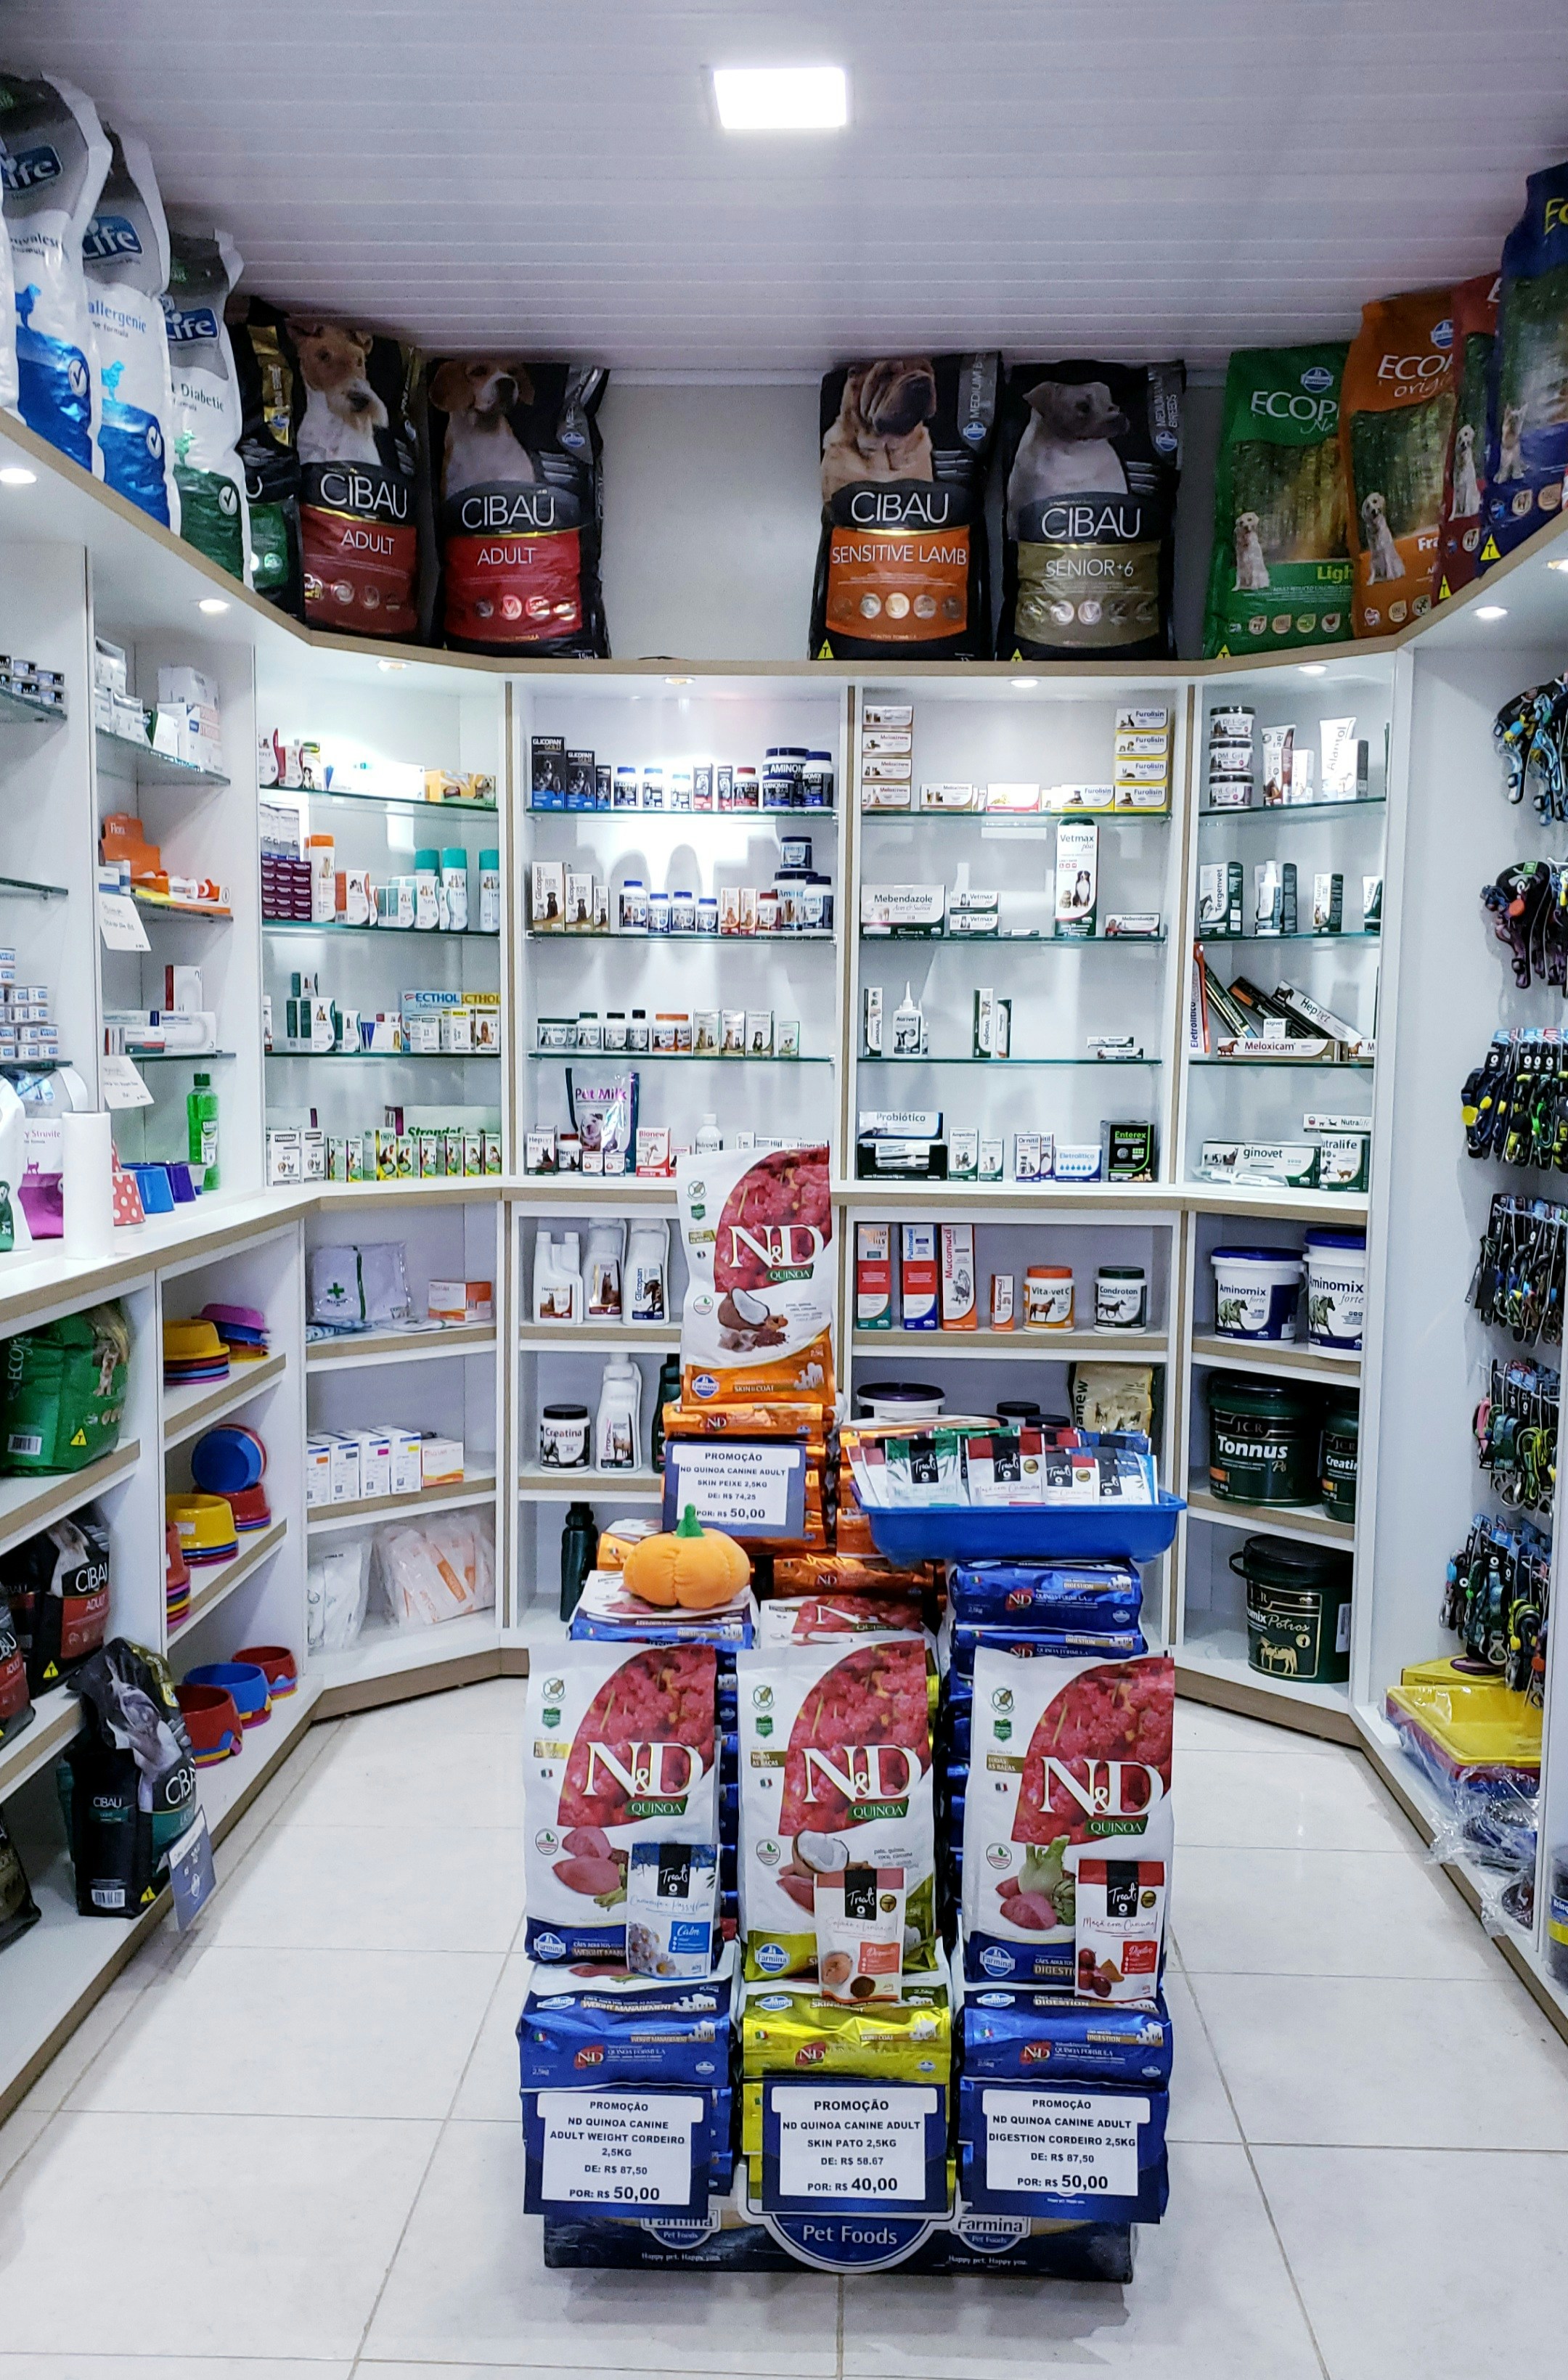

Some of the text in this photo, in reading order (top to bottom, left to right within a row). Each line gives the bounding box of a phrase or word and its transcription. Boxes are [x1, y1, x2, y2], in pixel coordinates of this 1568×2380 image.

[1250, 391, 1338, 420] ECOP
[320, 473, 407, 520] CIBAU
[462, 496, 555, 528] CIBAU
[851, 491, 949, 523] CIBAU
[1042, 507, 1140, 539] CIBAU
[341, 530, 394, 555] ADULT
[477, 547, 536, 565] ADULT
[832, 544, 967, 565] SENSITIVE LAMB
[874, 894, 933, 904] Mebendazole
[416, 993, 460, 1002] ECTHOL
[1244, 1041, 1294, 1051] Meloxicam
[576, 1087, 627, 1100] Pet Milk
[876, 1112, 926, 1122] Probiótico
[31, 1129, 61, 1139] Struvite
[1244, 1147, 1283, 1159] ginovet
[729, 1224, 824, 1268] N&D
[770, 1270, 811, 1280] QUINOA
[1220, 1284, 1266, 1296] Aminomix
[1309, 1275, 1363, 1293] Aminomix
[1100, 1286, 1138, 1296] Condroton
[1339, 1292, 1363, 1306] forte
[545, 1428, 582, 1438] Creatina
[1218, 1435, 1288, 1459] Tonnus
[705, 1452, 762, 1463] PROMOÇÃO
[730, 1508, 765, 1520] 50,00
[1267, 1614, 1310, 1632] Potros
[582, 1742, 703, 1797] N&D
[801, 1745, 922, 1803] N&D
[1039, 1757, 1163, 1816] N&D
[93, 1796, 122, 1807] CIBAU
[632, 1802, 682, 1814] QUINOA
[854, 1805, 904, 1818] QUINOA
[1090, 1821, 1145, 1833] QUINOA
[660, 1864, 688, 1885] Treats
[847, 1888, 875, 1907] Treats
[1108, 1882, 1138, 1904] Treats
[677, 1925, 700, 1937] Calm
[589, 2101, 648, 2112] PROMOÇÃO
[814, 2099, 889, 2113] PROMOÇÃO
[1032, 2099, 1091, 2111] PROMOÇÃO
[586, 2118, 626, 2127] QUINOA
[629, 2120, 669, 2129] CANINE
[801, 2122, 841, 2130] QUINOA
[1010, 2117, 1051, 2126] QUINOA
[1055, 2119, 1093, 2127] CANINE
[550, 2130, 685, 2144] ADULT WEIGHT CORDEIRO
[989, 2133, 1135, 2147] DIGESTION CORDEIRO 2,5KG
[867, 2140, 897, 2148] 2,5KG
[602, 2148, 632, 2157] 2,5KG
[1050, 2154, 1063, 2162] R$
[1067, 2154, 1094, 2164] 87,50
[841, 2157, 853, 2166] R$
[584, 2164, 648, 2175] DE: R$ 87,50
[836, 2183, 847, 2191] R$
[852, 2177, 897, 2193] 40,00
[1018, 2175, 1108, 2191] POR: R$ 50,00
[569, 2186, 660, 2201] POR: R$ 50,00
[957, 2217, 1023, 2233] Farmina
[803, 2225, 897, 2245] Pet Foods
[949, 2255, 971, 2265] Happy
[973, 2256, 986, 2265] pet.
[989, 2257, 1011, 2267] Happy
